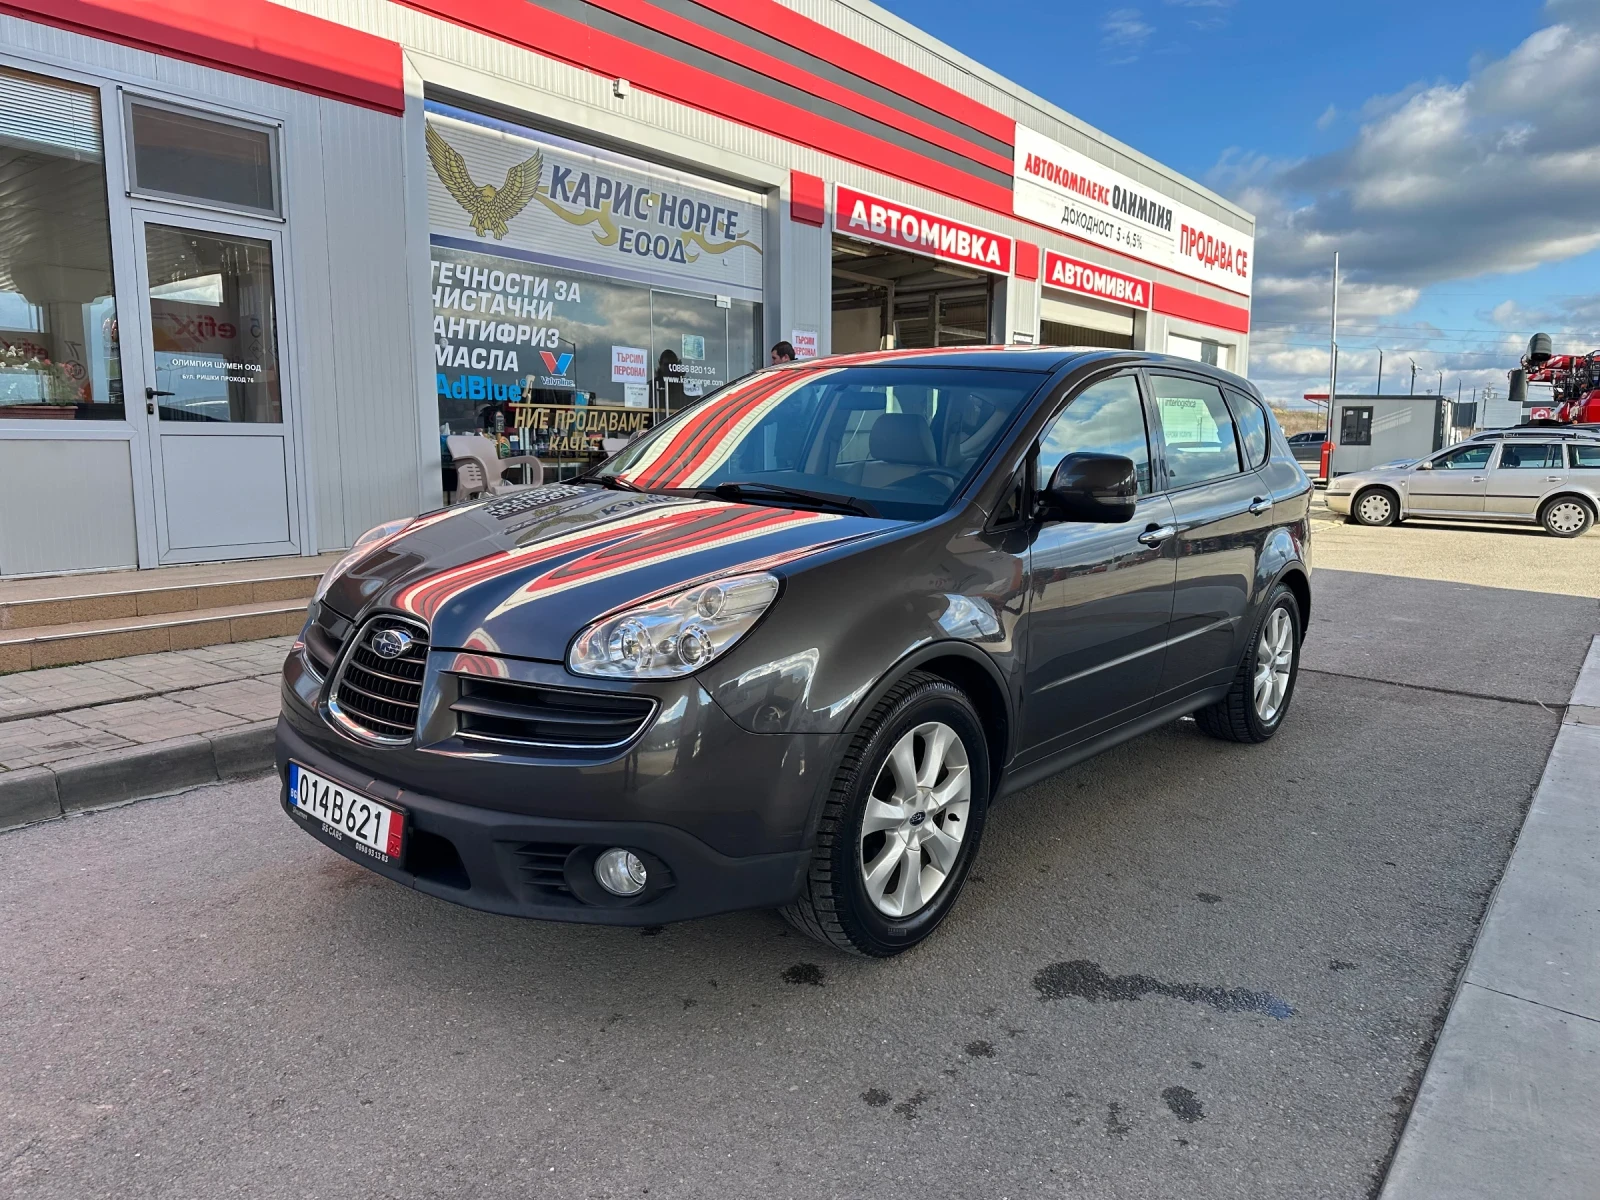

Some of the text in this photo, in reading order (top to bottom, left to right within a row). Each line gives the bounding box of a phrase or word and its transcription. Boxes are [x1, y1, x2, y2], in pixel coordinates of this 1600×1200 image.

[550, 165, 739, 241] КАРИС НОРГЕ
[1024, 153, 1173, 232] АВТОКОМПЛЕКС ОЛИМПИЯ
[849, 199, 1001, 266] АВТОМИВКА
[1061, 205, 1115, 239] ДОХОДНОСТ
[619, 227, 687, 264] ЕООД
[1180, 223, 1248, 278] ПРОДАВА СЕ
[554, 280, 581, 303] ЗА
[1052, 259, 1144, 304] АВТОМИВКА
[433, 315, 560, 349] АНТИФРИЗ
[171, 358, 262, 373] ОЛИМПИЯ ШУМЕН ООД
[434, 343, 519, 373] МАСЛА
[613, 365, 646, 378] ПЕРСОНАЛ
[616, 352, 644, 365] ТЪРСИМ
[703, 366, 716, 375] 134
[220, 375, 247, 384] ПРОХОД
[514, 407, 551, 429] НИЕ
[554, 408, 650, 433] ПРОДАВАМЕ
[299, 773, 383, 846] 014B621
